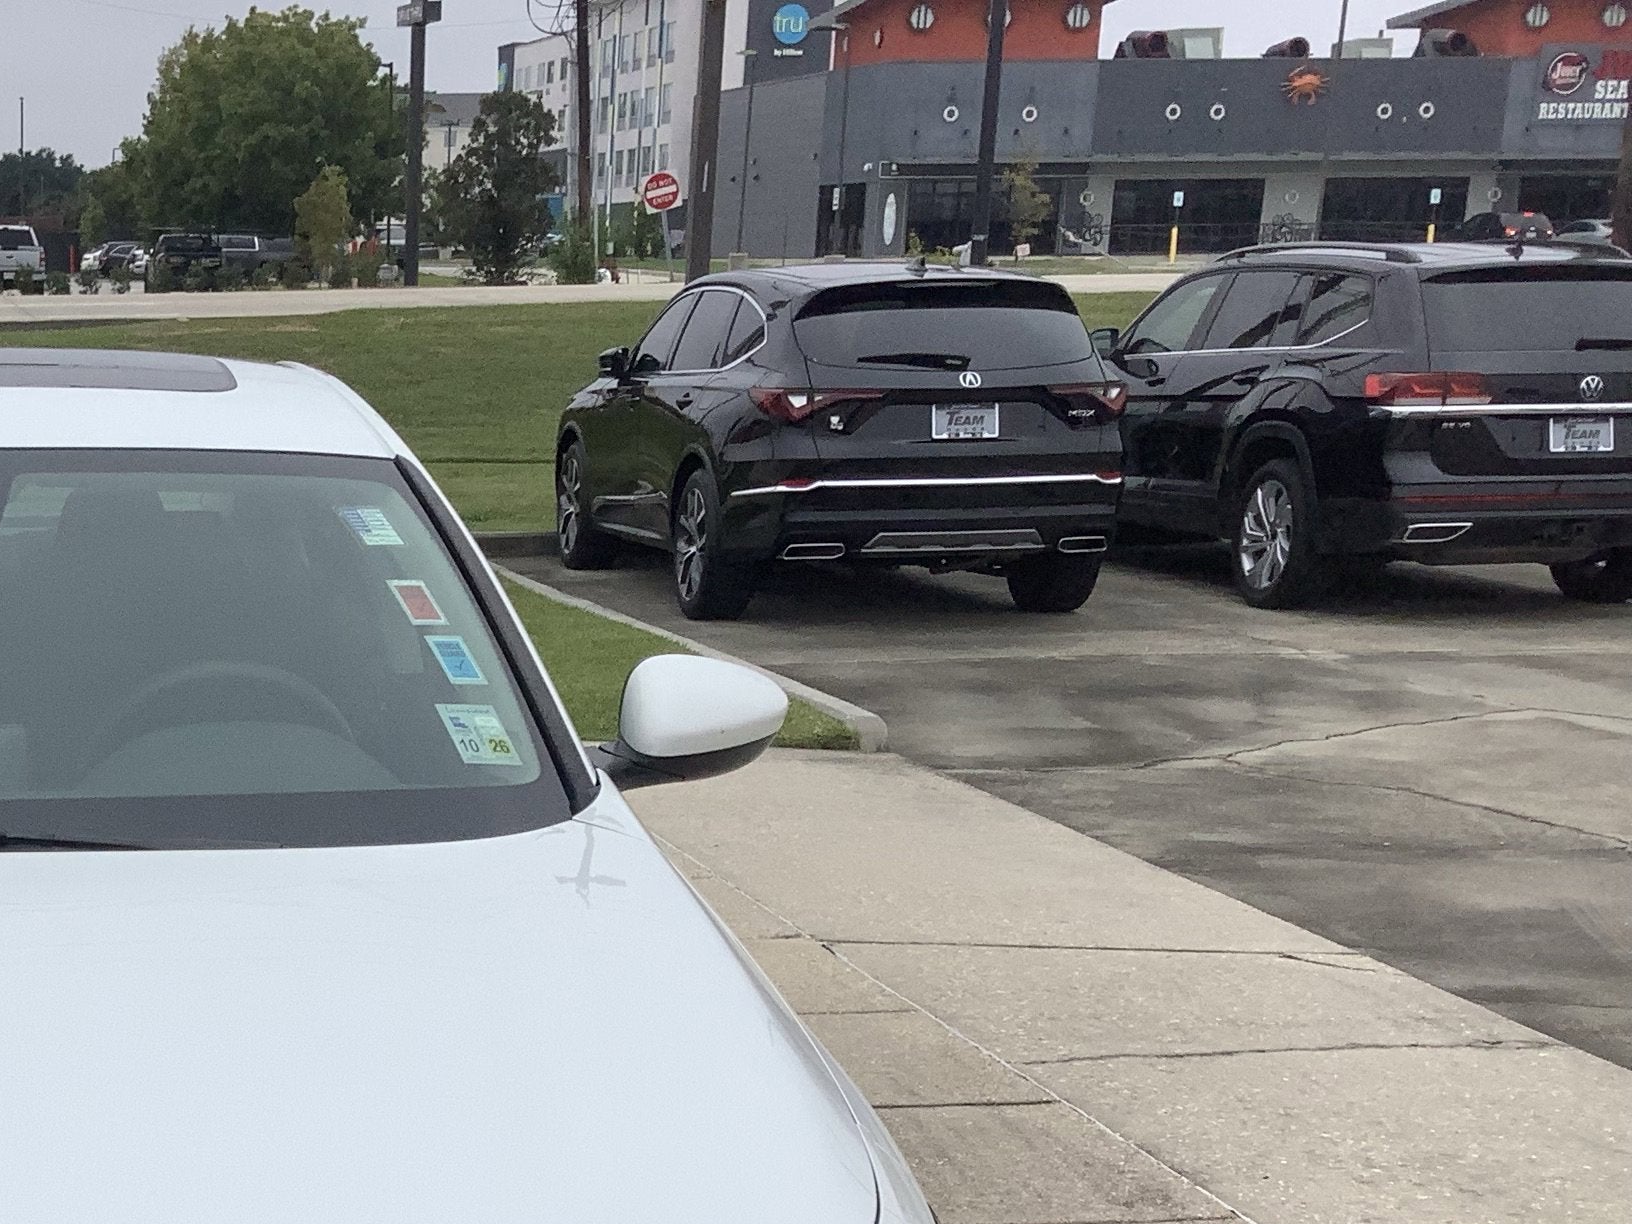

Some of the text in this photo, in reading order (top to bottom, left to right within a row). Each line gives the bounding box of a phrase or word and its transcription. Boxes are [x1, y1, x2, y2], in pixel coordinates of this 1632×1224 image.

[647, 177, 673, 190] DO NOT
[653, 194, 674, 206] ENTER
[946, 411, 985, 426] TEAM
[1563, 423, 1600, 440] TEAM
[459, 738, 511, 754] 10 26
